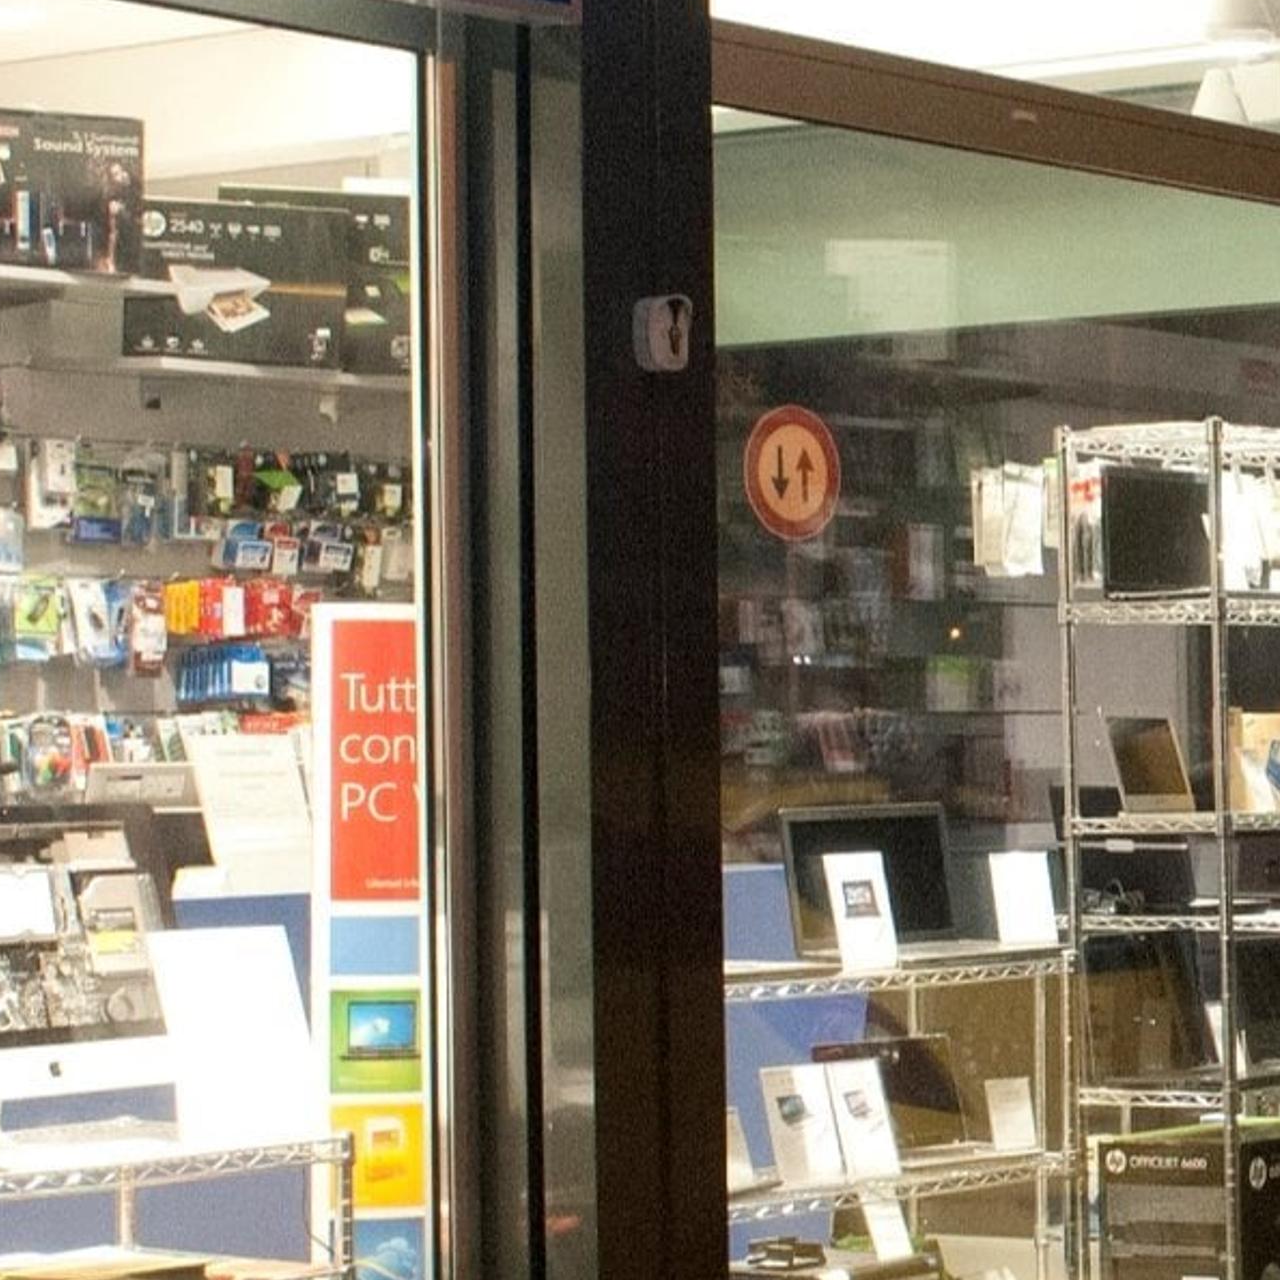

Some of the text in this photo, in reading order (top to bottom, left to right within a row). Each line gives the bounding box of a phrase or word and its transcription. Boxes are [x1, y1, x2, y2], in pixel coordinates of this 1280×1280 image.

[32, 136, 139, 160] Sound System
[339, 733, 415, 765] con
[340, 781, 399, 822] PC
